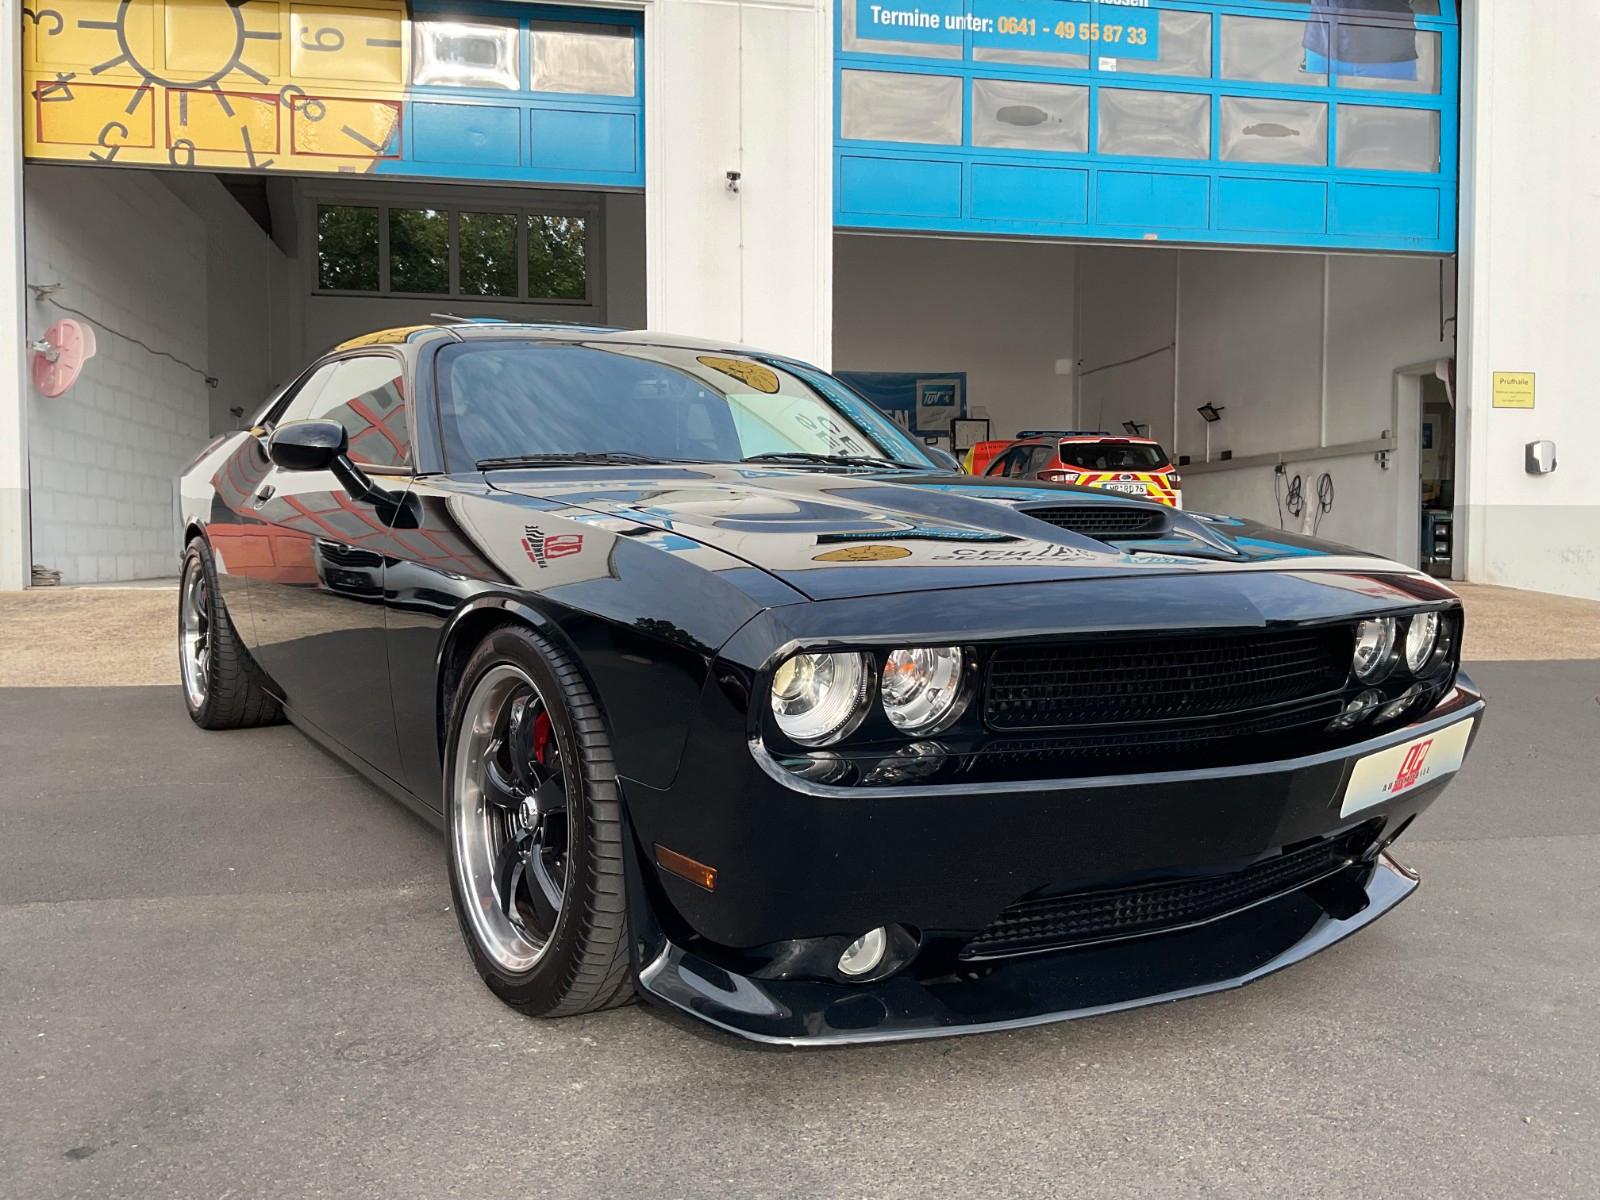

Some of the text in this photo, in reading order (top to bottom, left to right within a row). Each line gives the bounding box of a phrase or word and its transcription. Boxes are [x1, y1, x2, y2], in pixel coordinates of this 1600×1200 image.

[870, 5, 940, 29] Termine
[944, 13, 993, 33] unter:
[997, 16, 1036, 36] 0641
[1054, 21, 1075, 39] 49
[1079, 22, 1099, 41] 55
[1103, 24, 1123, 43] 87
[1127, 26, 1147, 45] 33
